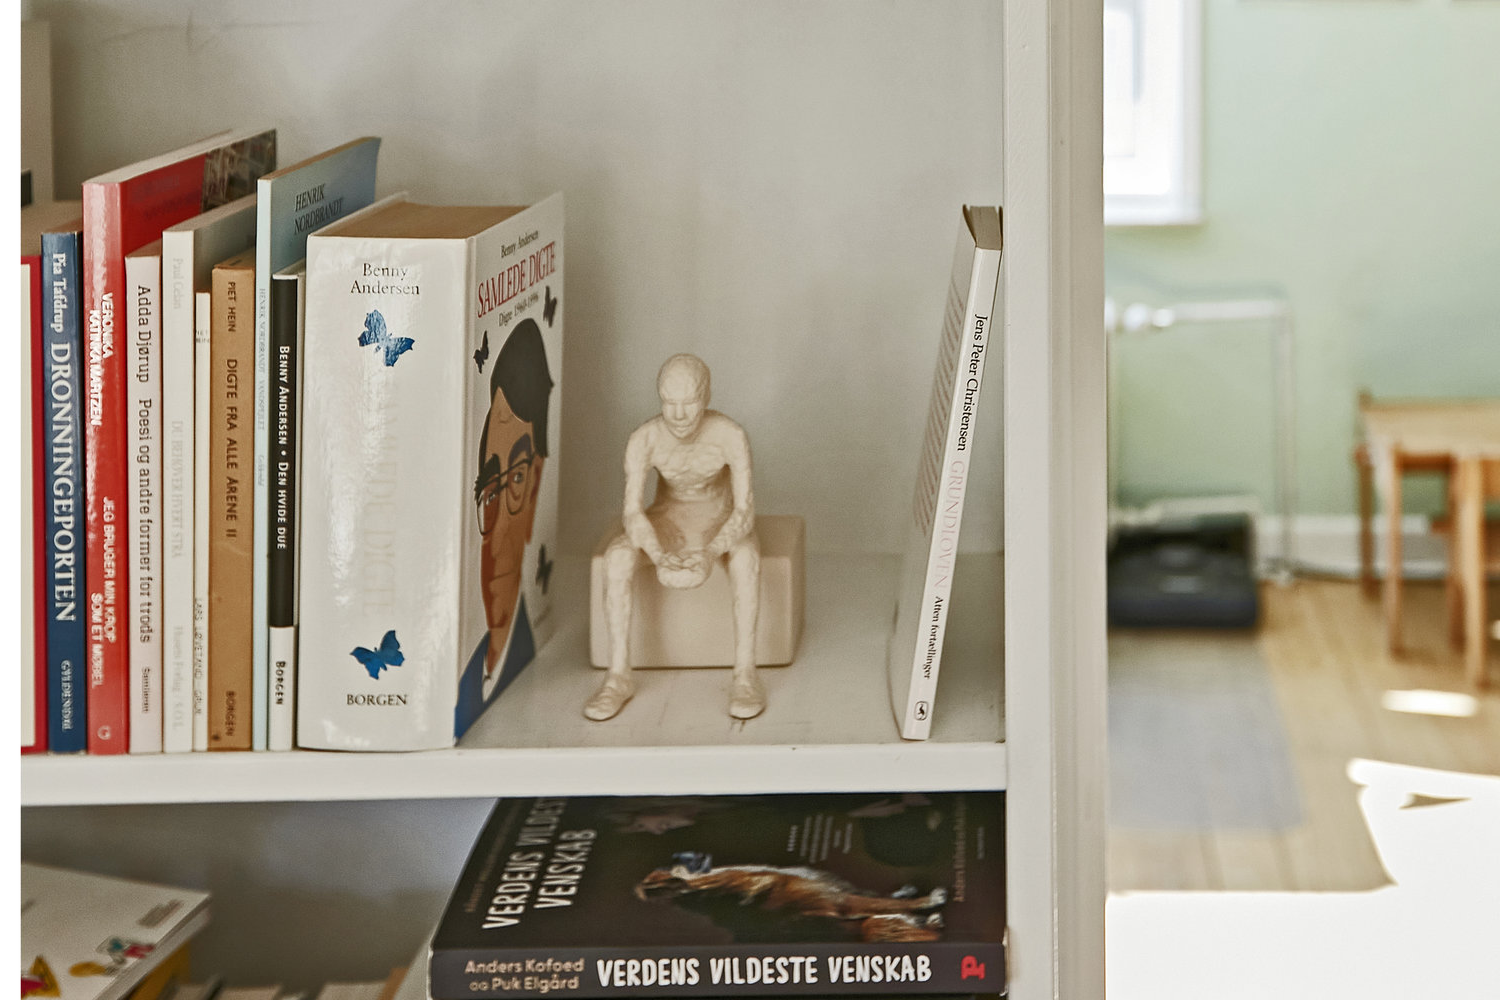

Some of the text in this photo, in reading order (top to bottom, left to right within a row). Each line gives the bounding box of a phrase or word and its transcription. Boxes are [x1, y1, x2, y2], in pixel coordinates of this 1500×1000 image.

[51, 253, 70, 333] Pia Tafdrup
[351, 280, 420, 295] Andersen
[363, 263, 408, 281] Benny
[477, 241, 556, 318] SAMLEDE DIGTE
[137, 285, 151, 383] Adda Djørup
[958, 314, 988, 452] Jens Peter Christensen
[138, 399, 152, 442] Poesi
[51, 343, 76, 622] DRONNINGEPORTEN
[464, 958, 585, 974] Anders Kofoed
[491, 976, 521, 990] Puk
[523, 974, 580, 994] Elgård
[597, 954, 932, 988] VERDENS VILDESTE VENSKAB
